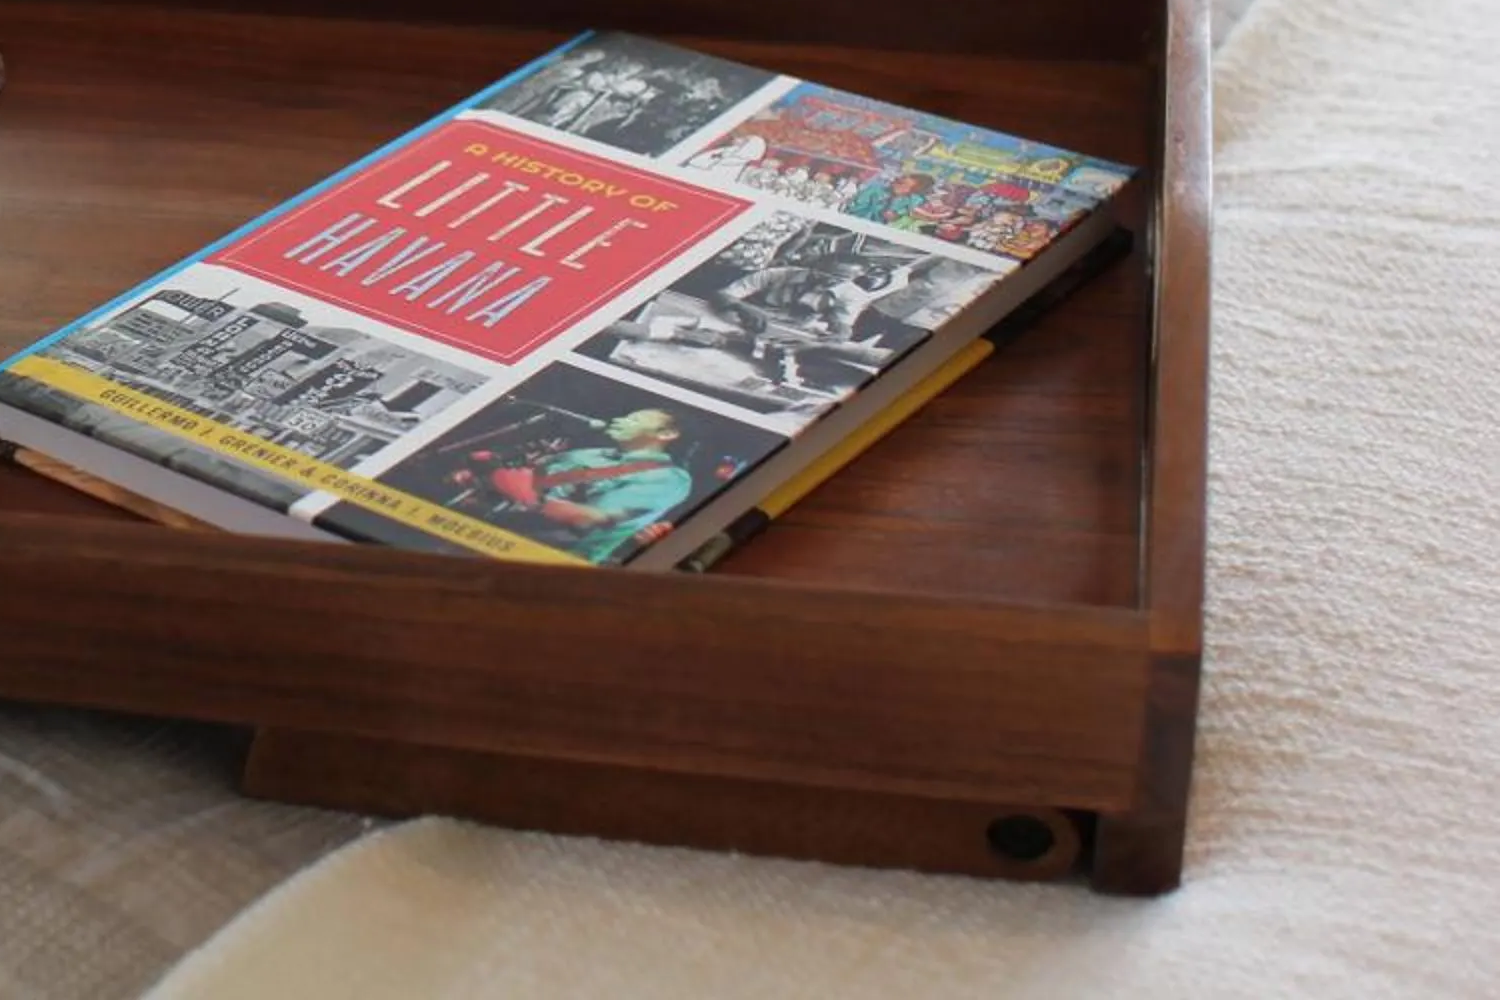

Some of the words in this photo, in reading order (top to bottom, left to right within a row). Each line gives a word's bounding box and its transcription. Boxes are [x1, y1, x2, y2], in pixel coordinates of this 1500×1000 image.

[377, 159, 649, 271] LITTLE
[463, 142, 486, 157] A
[492, 151, 628, 199] HISTORY
[627, 193, 680, 215] OF
[283, 212, 555, 328] HAVANA
[100, 388, 199, 431] GUILLERMO
[219, 434, 298, 470] GRENIER
[320, 473, 403, 508] CORINNA
